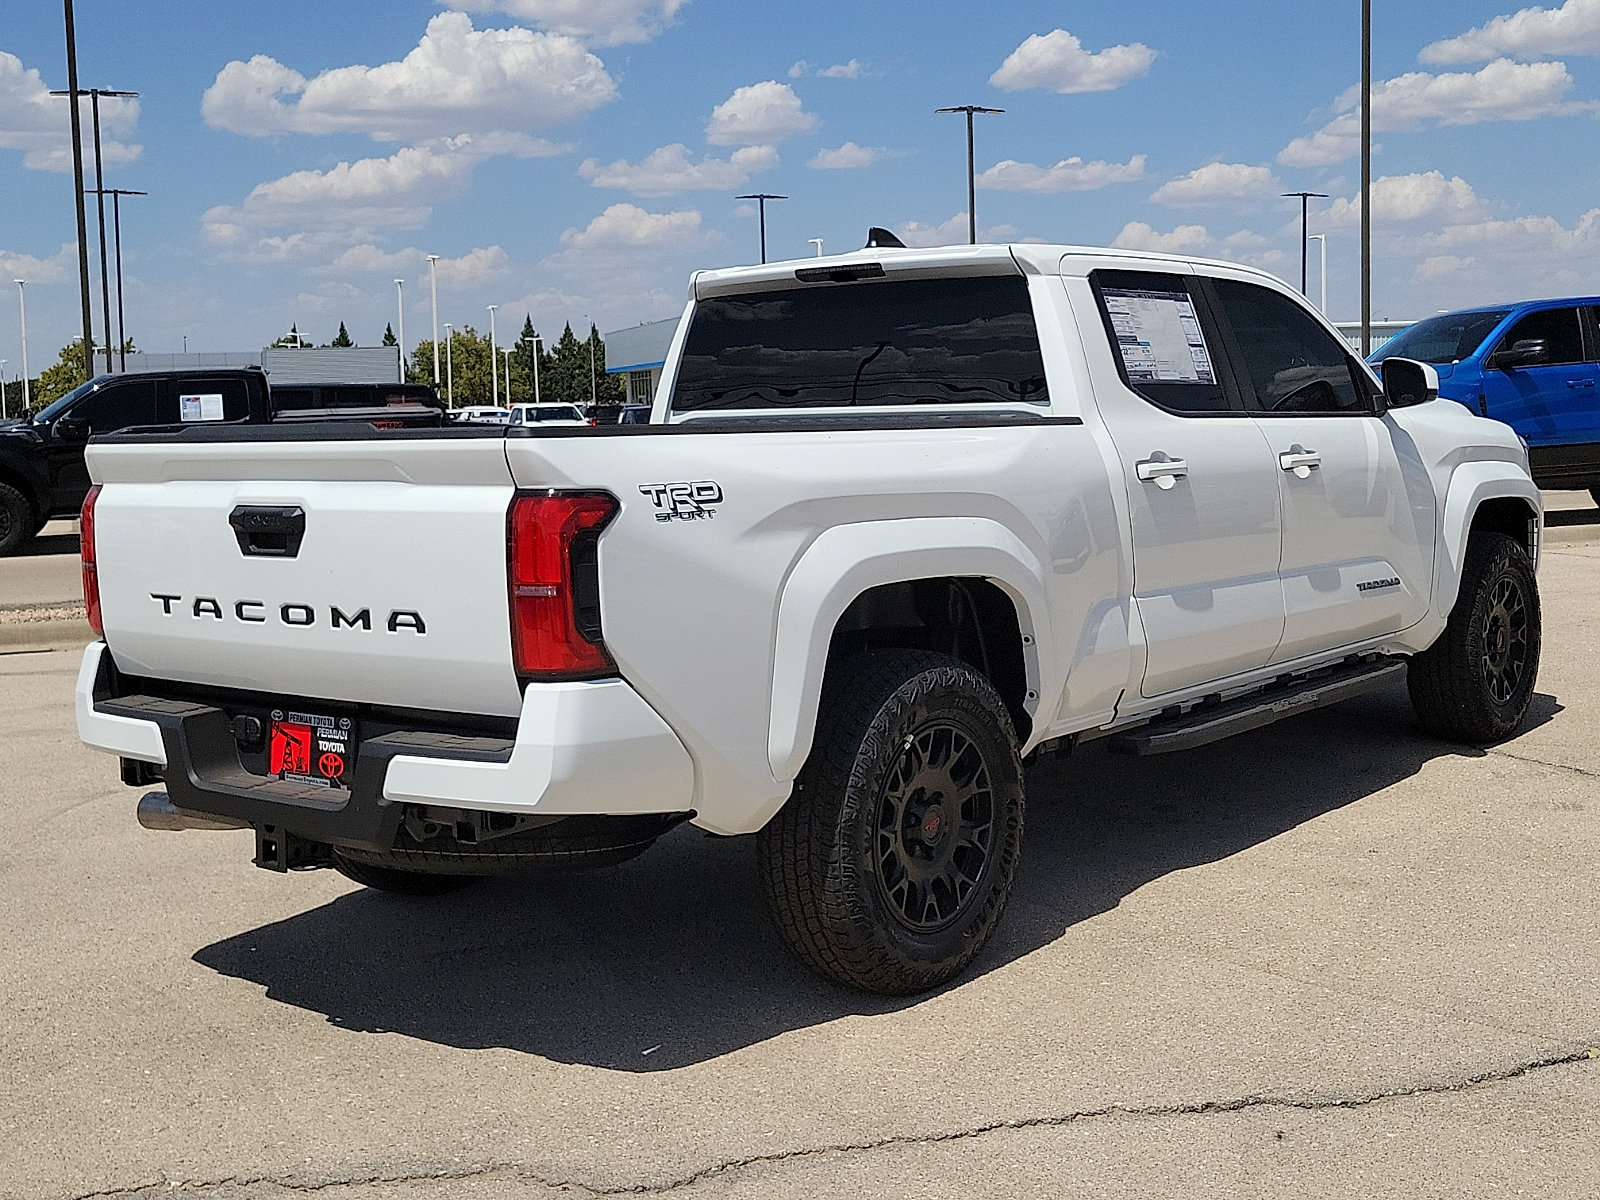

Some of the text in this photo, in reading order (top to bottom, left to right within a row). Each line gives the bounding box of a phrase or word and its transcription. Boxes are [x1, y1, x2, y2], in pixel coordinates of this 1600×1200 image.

[638, 480, 724, 511] TRD
[655, 509, 717, 523] SPORT
[150, 593, 427, 634] TACOMA
[289, 713, 334, 728] PERMIAN TOYOTA
[317, 728, 347, 740] PERMIAN
[318, 741, 345, 753] TOYOTA
